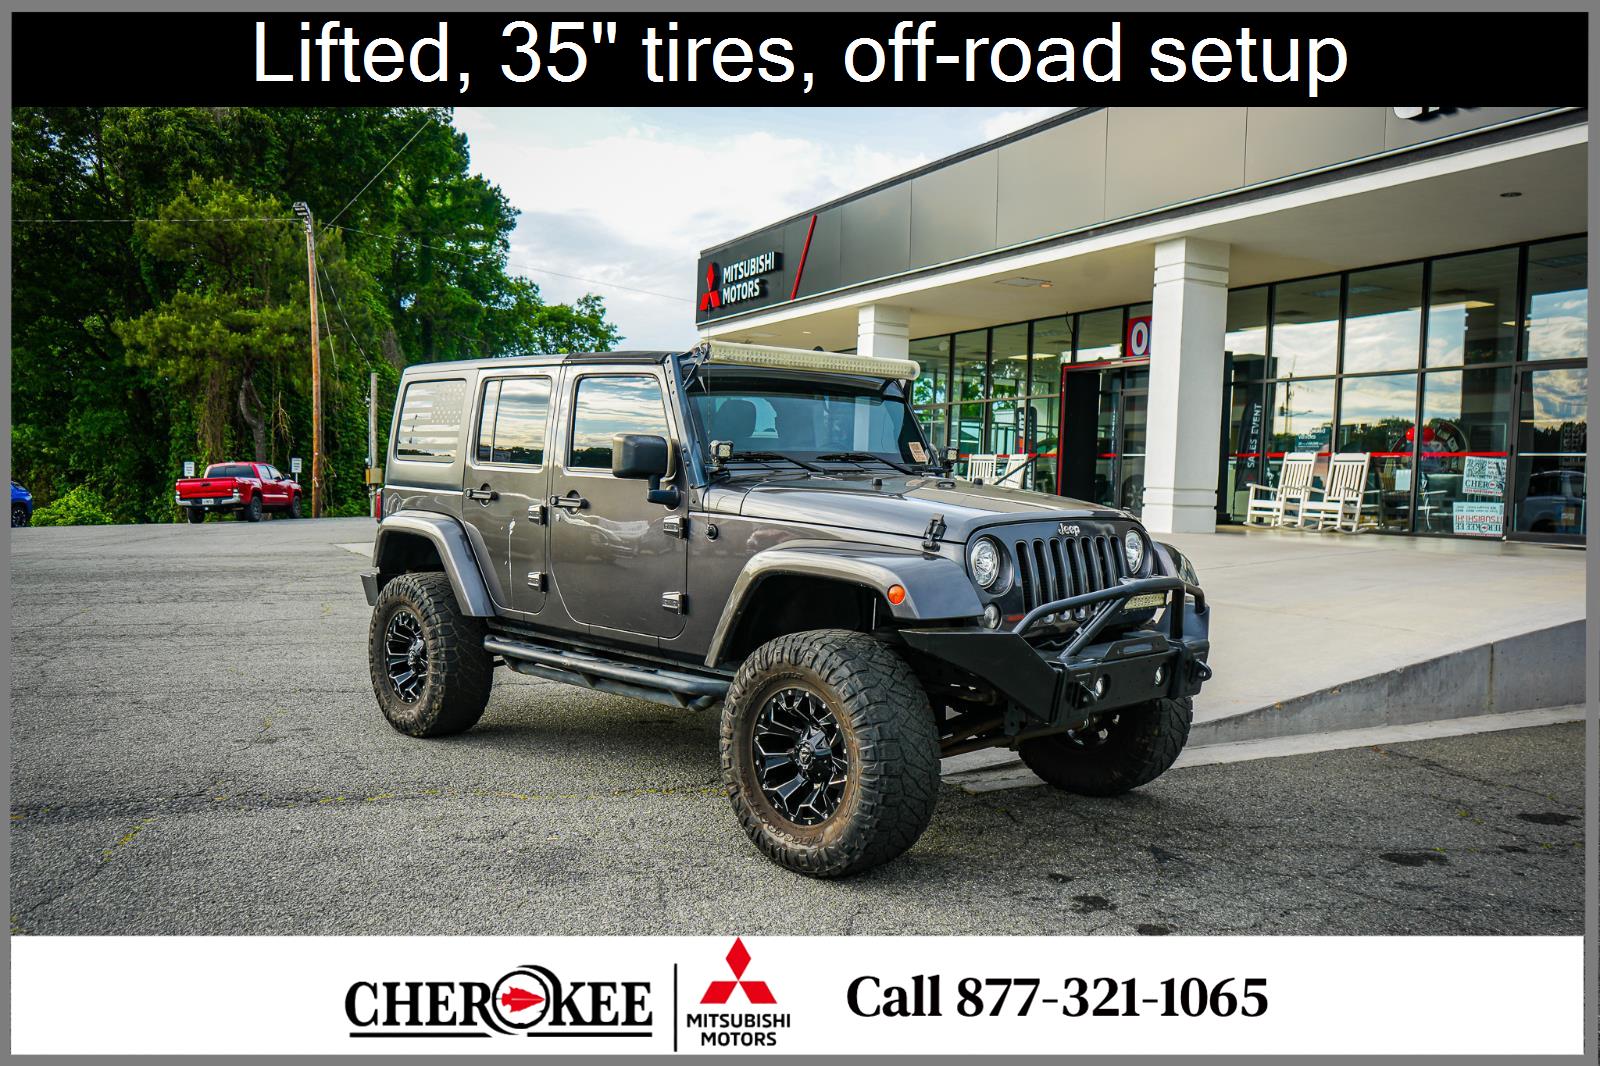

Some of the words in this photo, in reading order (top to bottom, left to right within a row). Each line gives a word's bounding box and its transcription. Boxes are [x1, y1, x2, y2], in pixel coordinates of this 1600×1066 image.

[722, 251, 775, 284] MITSUBISHI
[722, 278, 760, 305] MOTORS
[1251, 403, 1262, 435] EVENT
[1058, 522, 1080, 536] Jeep
